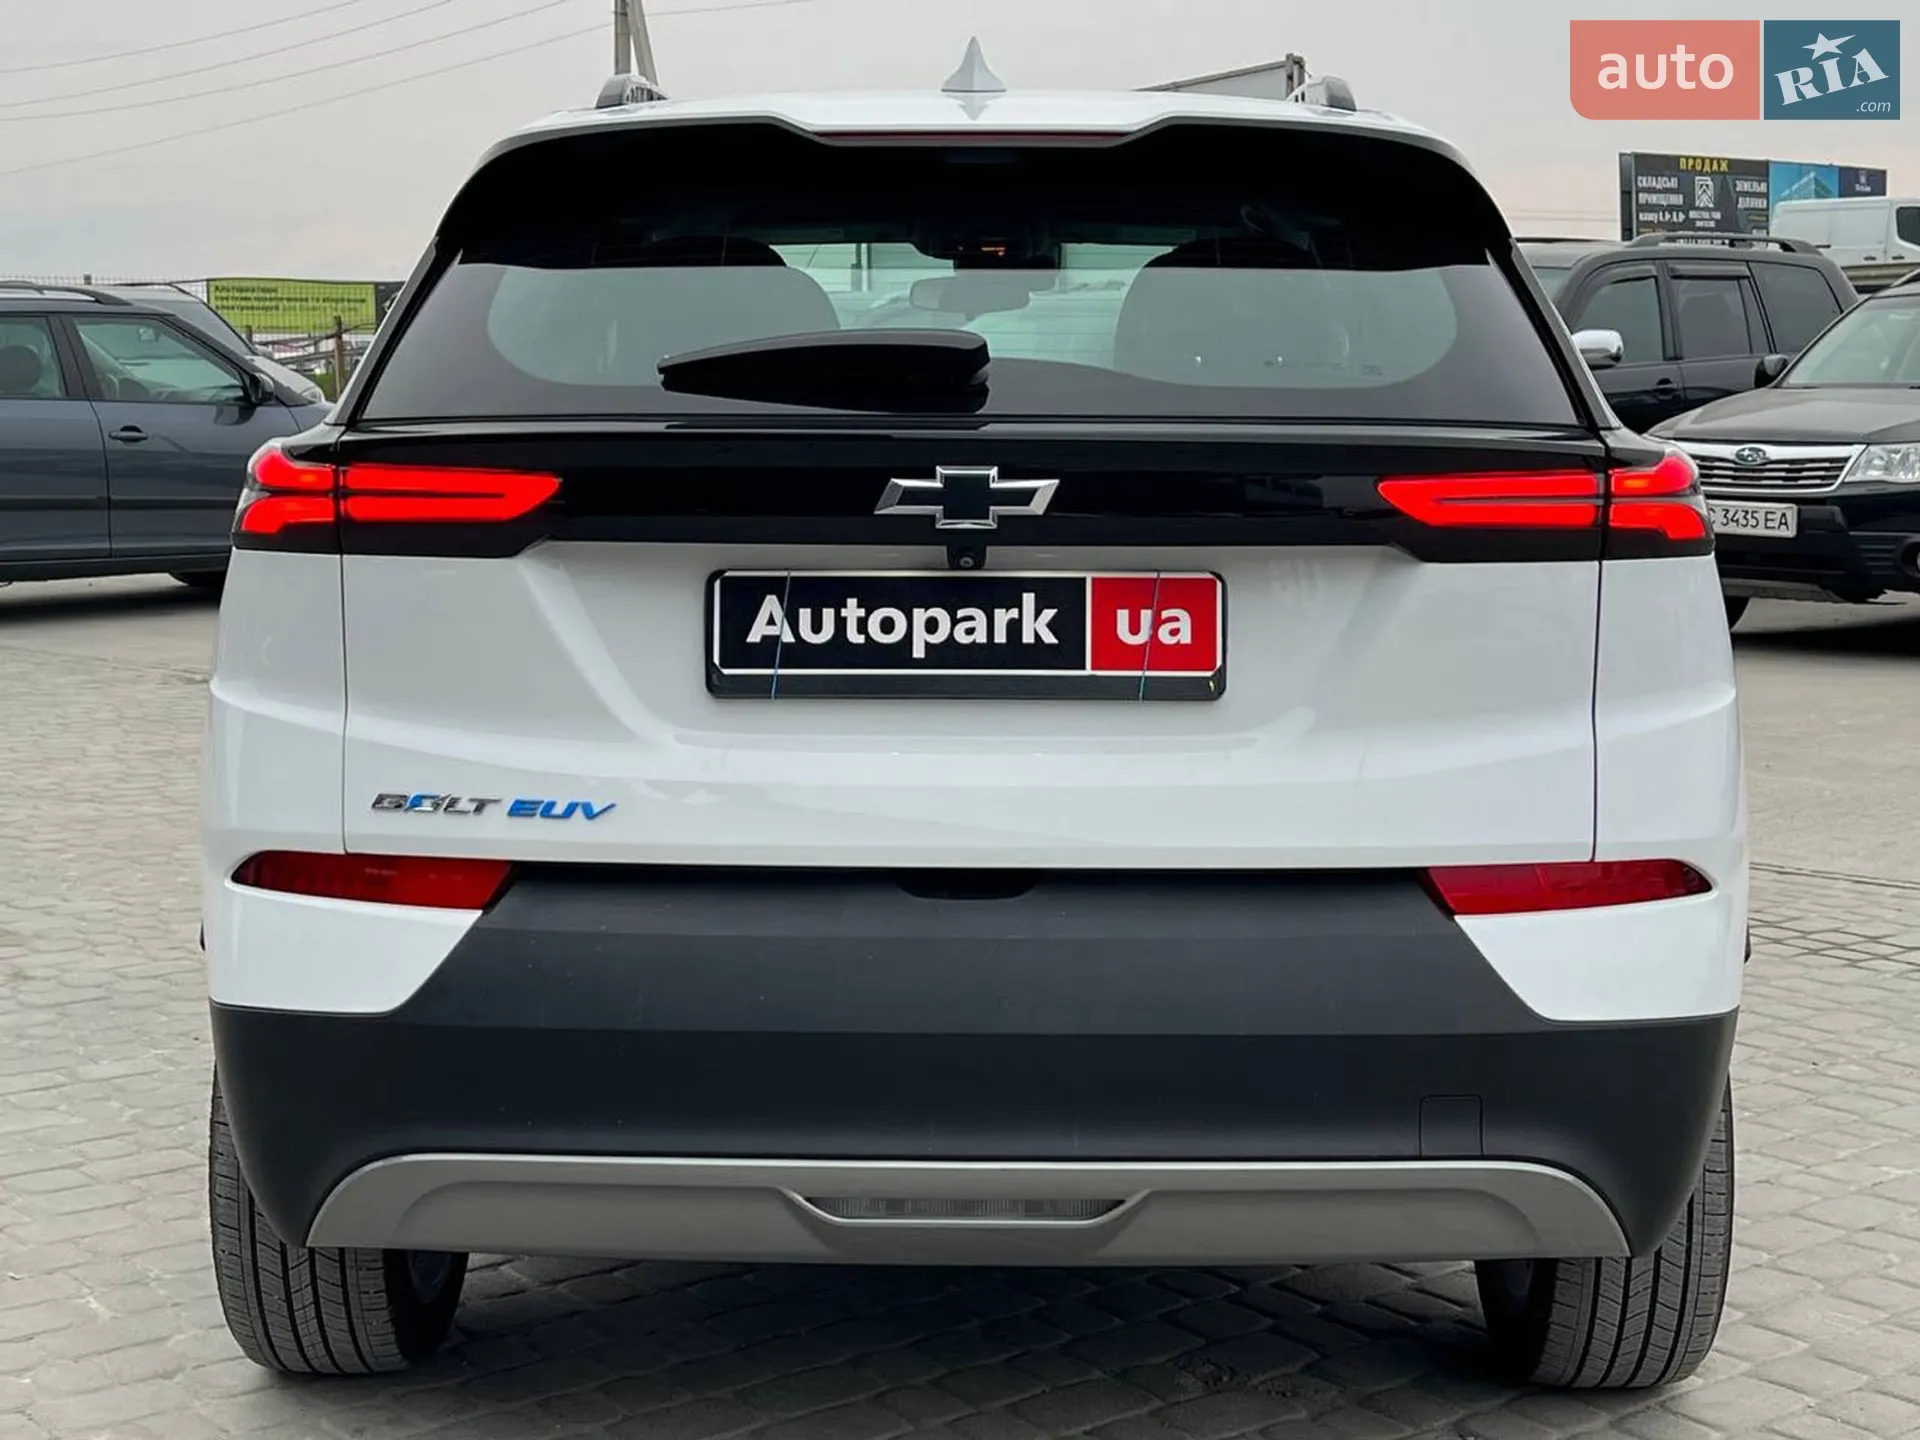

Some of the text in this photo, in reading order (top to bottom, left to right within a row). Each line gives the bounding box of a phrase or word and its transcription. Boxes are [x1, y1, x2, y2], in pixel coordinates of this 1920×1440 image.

[1679, 157, 1729, 173] ПРОДАЖ
[1720, 508, 1760, 529] 3435
[1764, 510, 1790, 531] EA
[746, 592, 1192, 659] Autopark ua
[370, 793, 617, 821] BOLT EUV
